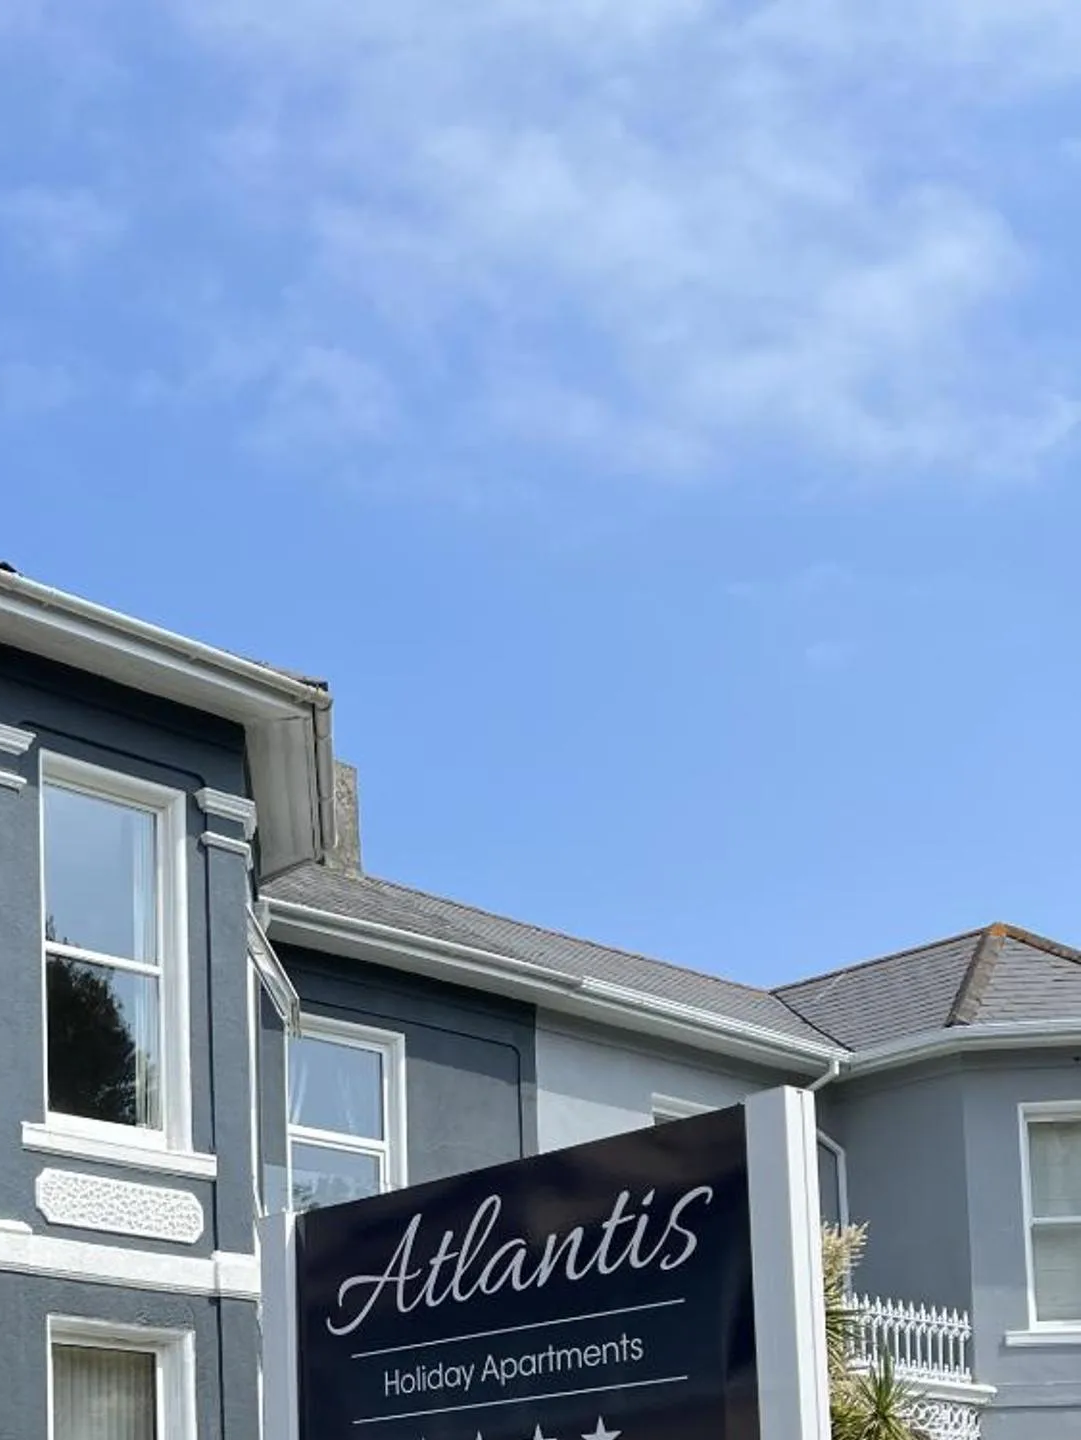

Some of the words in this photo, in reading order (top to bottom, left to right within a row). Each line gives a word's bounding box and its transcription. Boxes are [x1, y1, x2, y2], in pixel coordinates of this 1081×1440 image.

[327, 1185, 713, 1336] Atlantis
[384, 1360, 474, 1396] Holiday
[480, 1332, 644, 1386] Apartments
